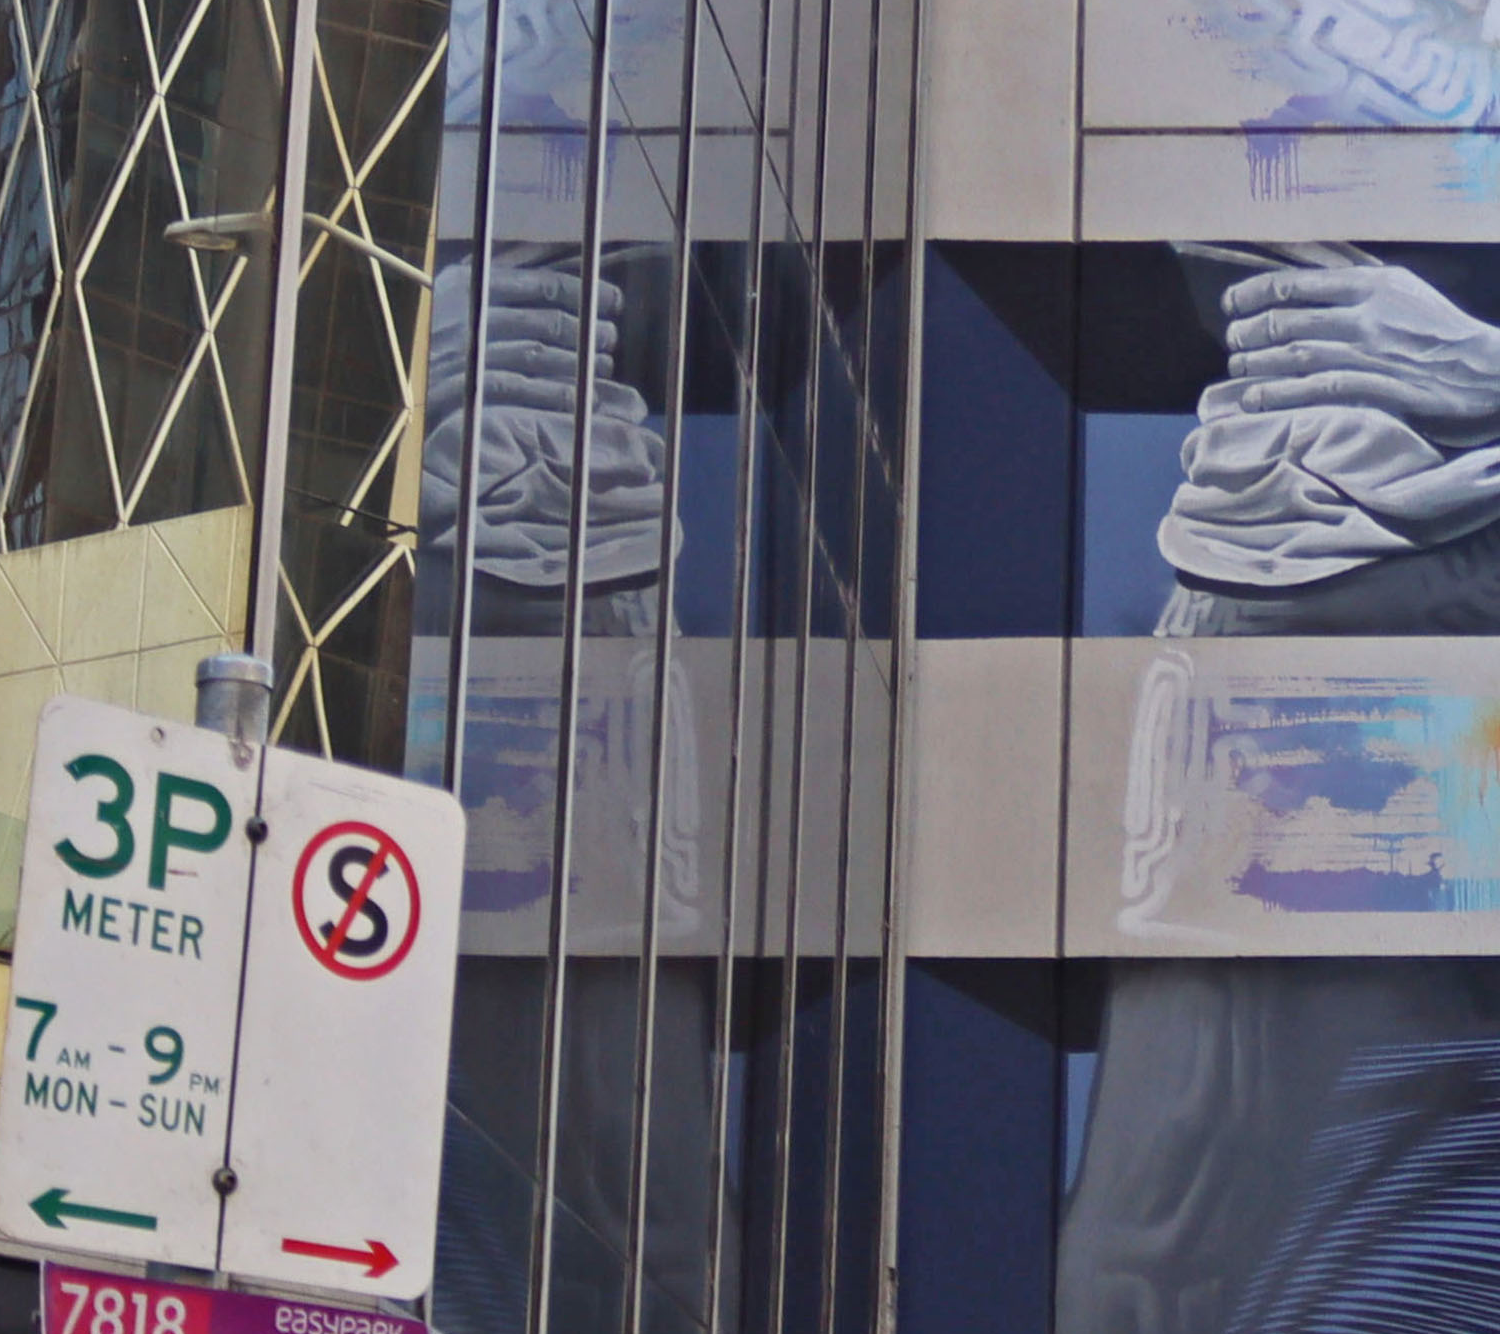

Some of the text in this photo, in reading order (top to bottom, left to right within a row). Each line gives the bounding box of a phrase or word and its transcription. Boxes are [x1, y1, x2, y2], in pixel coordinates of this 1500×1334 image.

[54, 754, 232, 891] 3P
[62, 889, 204, 960] METER
[16, 997, 57, 1062] 7
[57, 1048, 91, 1070] AM
[144, 1026, 184, 1085] 9
[189, 1074, 220, 1097] PM
[24, 1072, 98, 1117] MON
[137, 1093, 205, 1135] SUN
